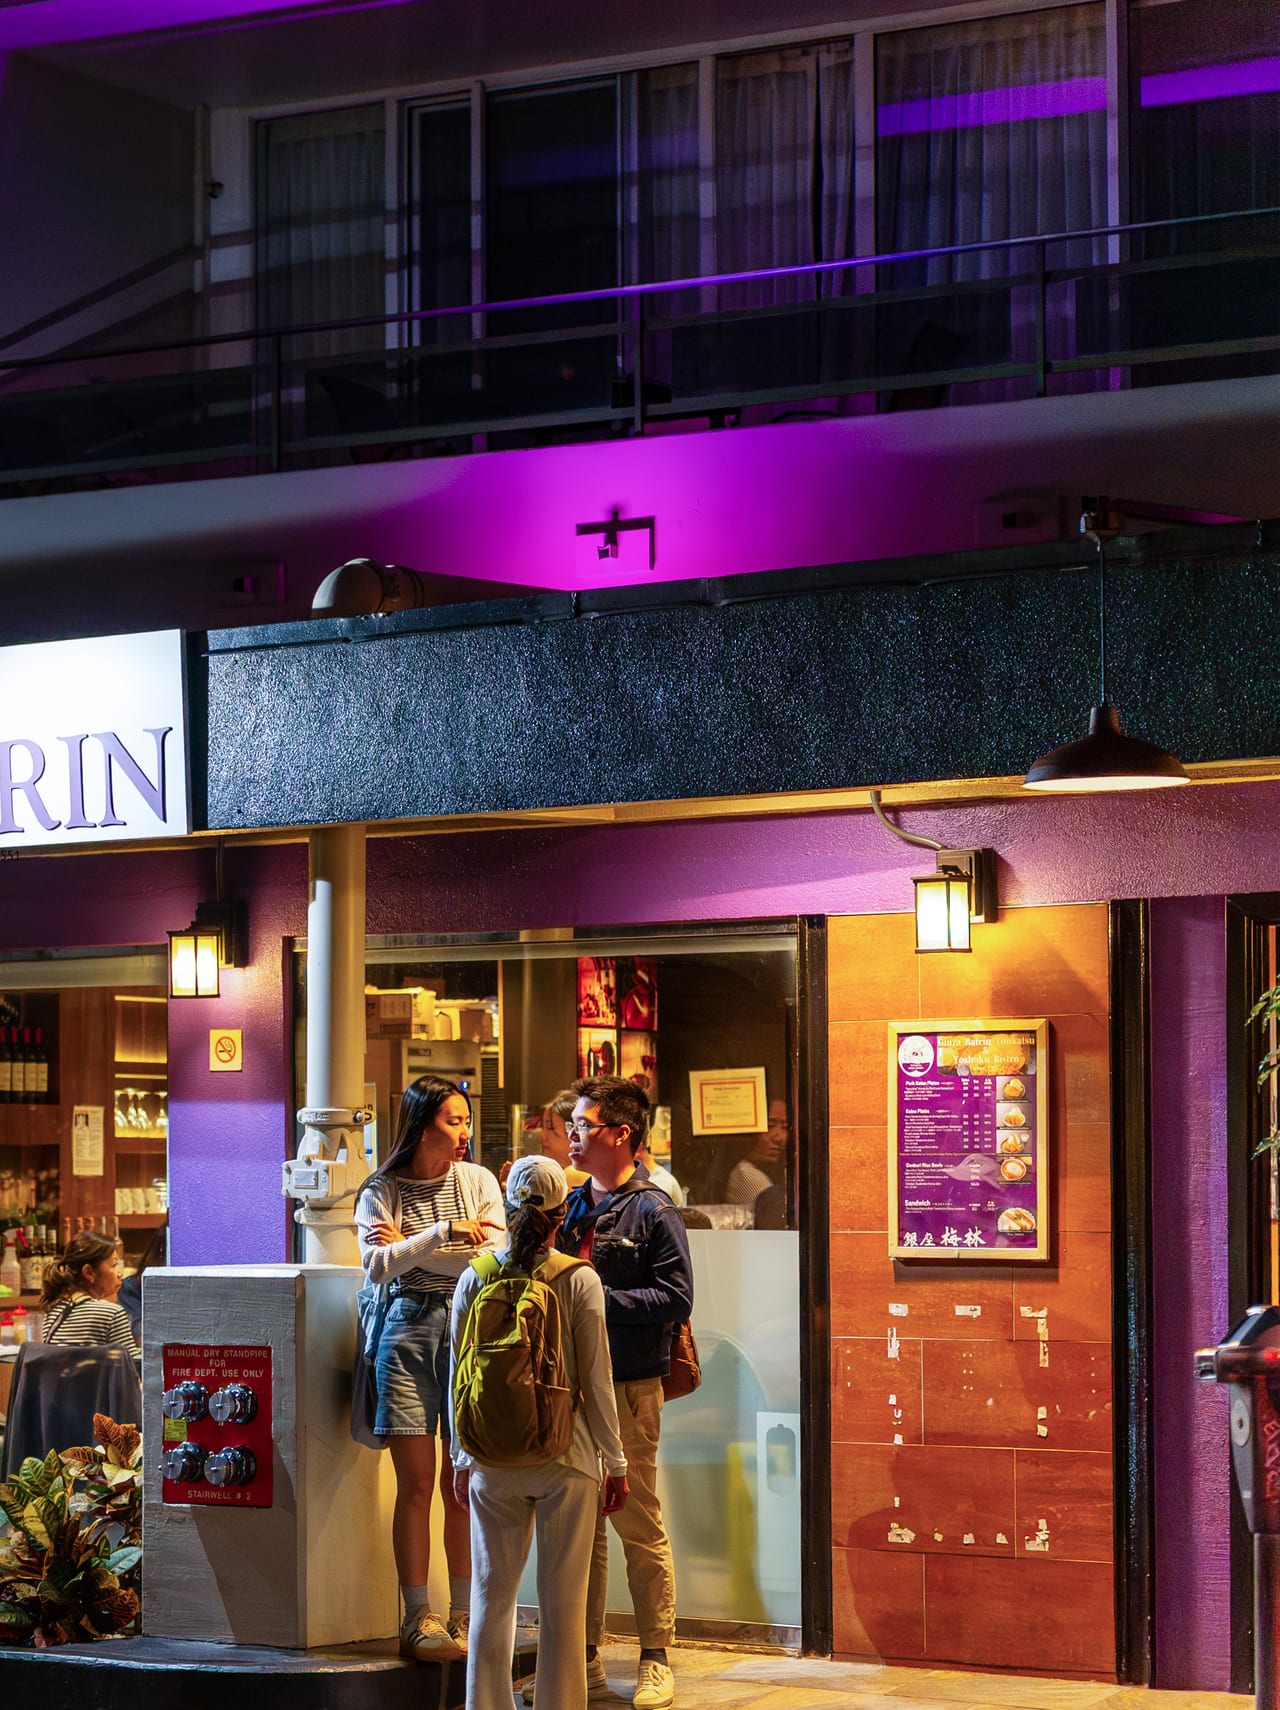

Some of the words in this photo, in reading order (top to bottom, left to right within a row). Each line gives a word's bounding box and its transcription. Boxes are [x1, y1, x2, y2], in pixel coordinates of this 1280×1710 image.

[965, 1037, 991, 1046] Bairin
[953, 1055, 990, 1064] Yoshoku
[994, 1055, 1020, 1063] Bistro
[167, 1349, 200, 1358] MANUAL
[204, 1349, 220, 1358] DRY
[223, 1350, 268, 1358] STANDPIPE
[209, 1359, 226, 1367] FOR
[172, 1368, 190, 1376] FIRE
[195, 1368, 218, 1377] DEPT.
[222, 1369, 238, 1377] USE
[242, 1370, 264, 1378] ONLY
[187, 1490, 231, 1500] STAIRWELL
[246, 1491, 251, 1500] 2
